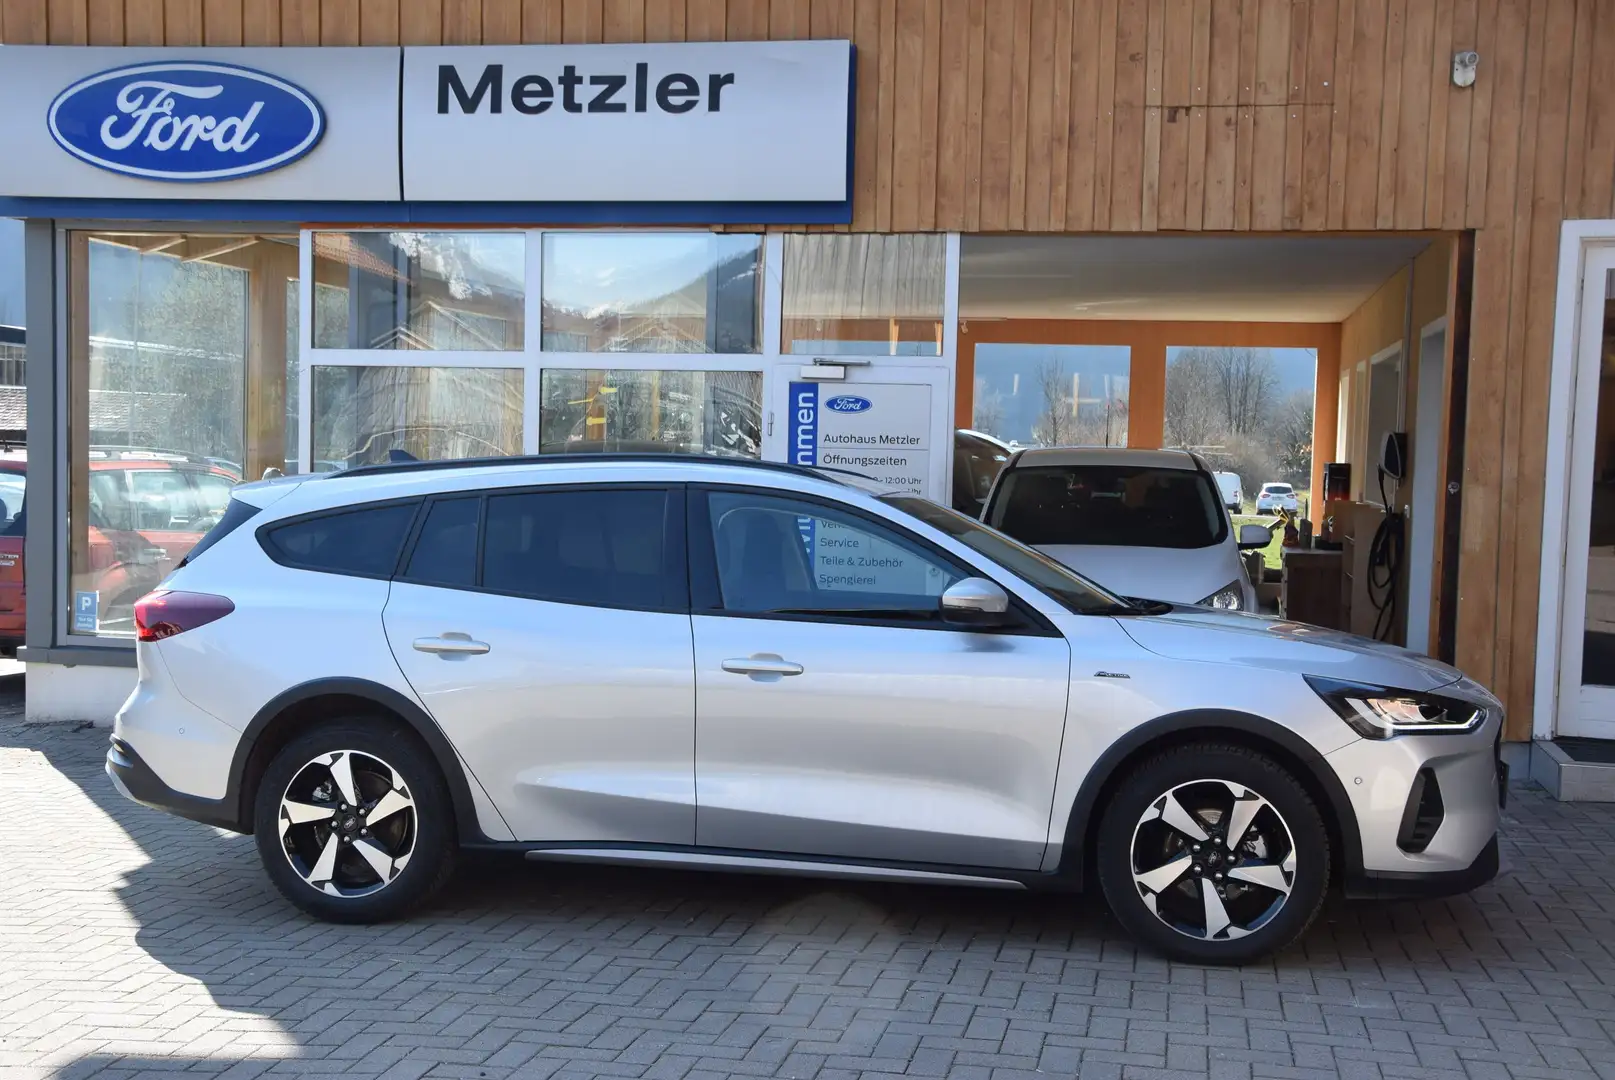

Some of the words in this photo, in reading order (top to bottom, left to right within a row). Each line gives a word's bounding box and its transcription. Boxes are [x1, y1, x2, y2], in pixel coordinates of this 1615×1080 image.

[437, 62, 735, 115] Metzler
[100, 80, 265, 153] Ford
[834, 397, 862, 410] Ford
[823, 433, 877, 444] Autohaus
[879, 434, 921, 445] Metzler
[823, 453, 907, 467] Öffnungszeiten
[885, 477, 906, 485] 12:00
[907, 477, 922, 485] Uhr
[820, 537, 859, 548] Service
[820, 556, 845, 566] Teile
[847, 557, 855, 566] &
[858, 557, 904, 568] Zubehör
[820, 574, 876, 586] Spenglerei
[81, 596, 92, 611] P
